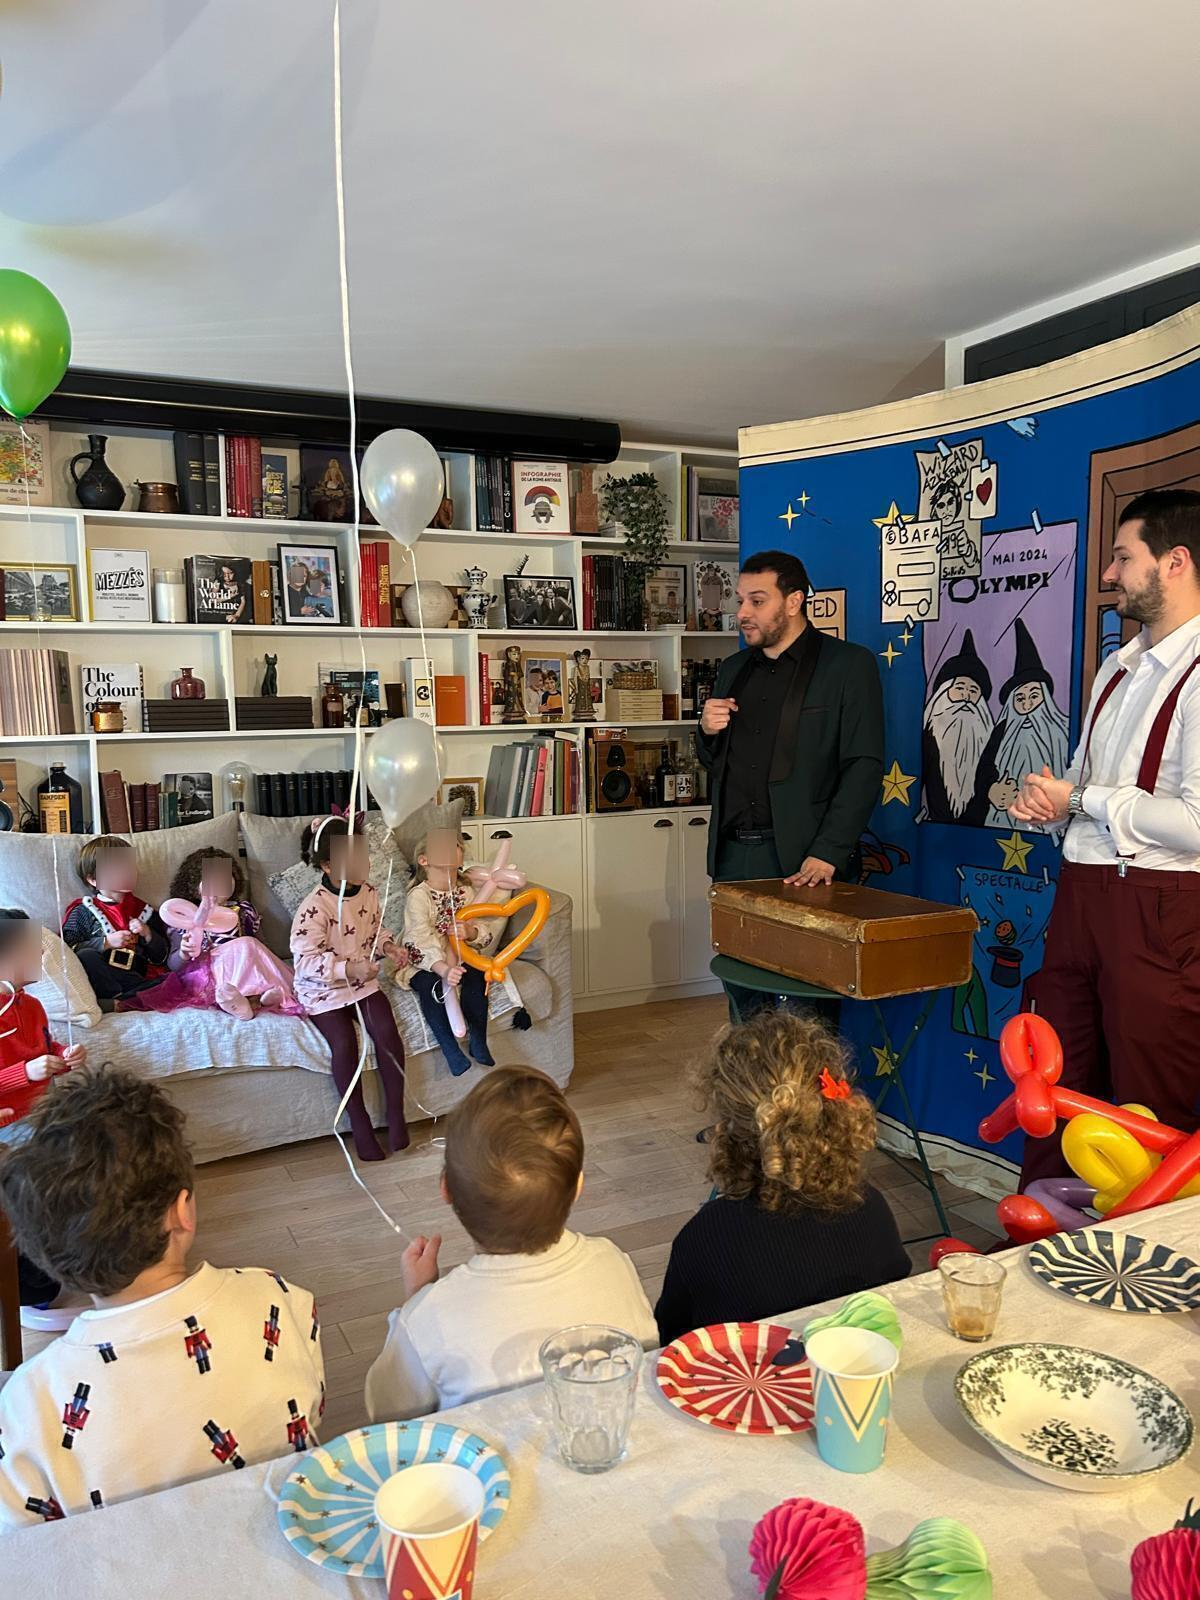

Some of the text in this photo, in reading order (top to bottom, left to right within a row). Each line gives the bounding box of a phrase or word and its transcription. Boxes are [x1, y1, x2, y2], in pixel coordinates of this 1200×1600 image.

[899, 527, 940, 544] BAFA
[992, 548, 1048, 566] MAI 2024
[95, 567, 144, 591] MEZZÉS
[197, 577, 220, 589] The
[199, 587, 231, 600] World
[199, 598, 240, 610] Aflame
[82, 667, 115, 682] The
[84, 682, 139, 697] Colour
